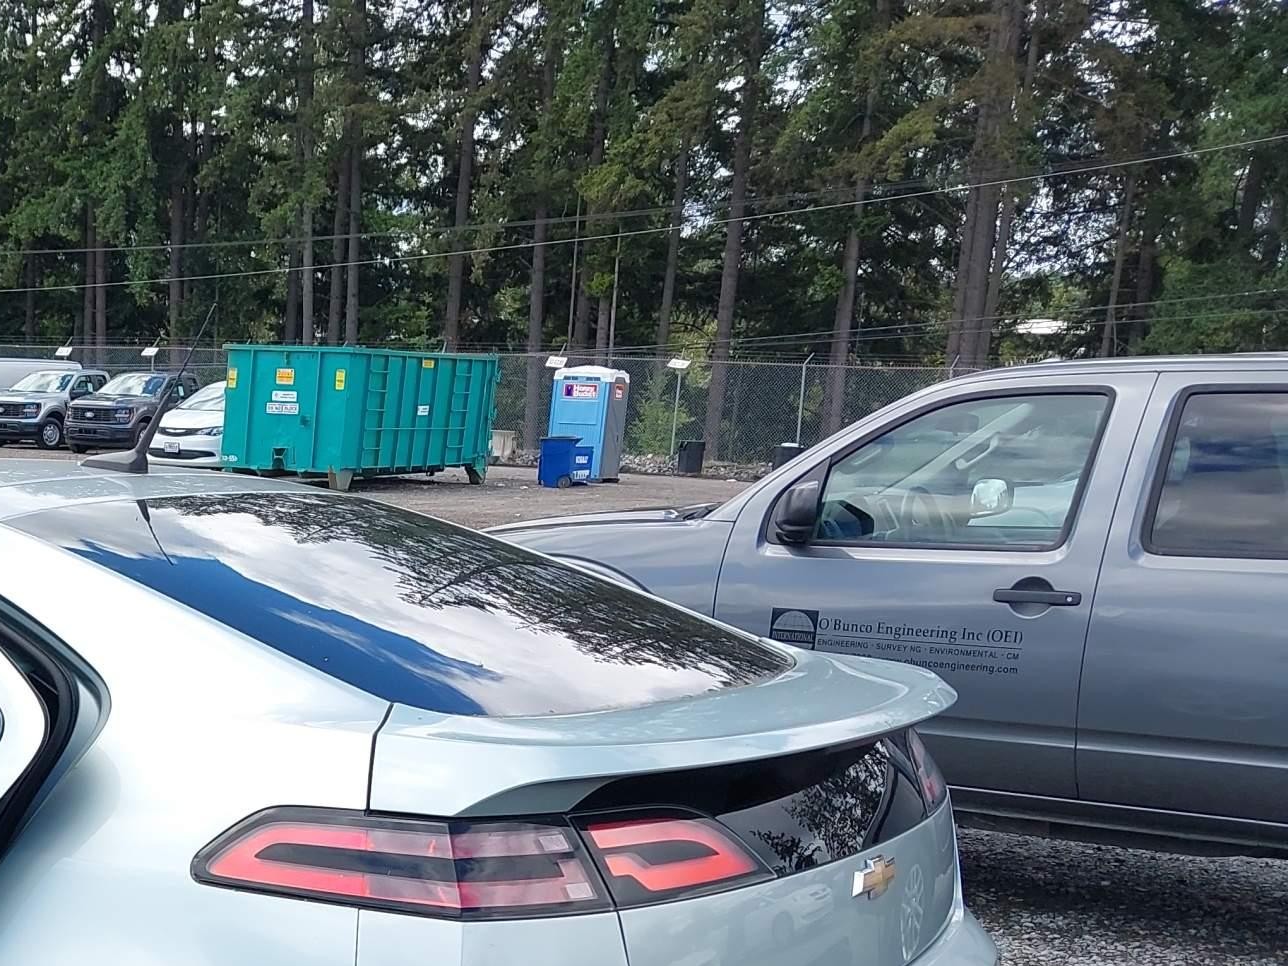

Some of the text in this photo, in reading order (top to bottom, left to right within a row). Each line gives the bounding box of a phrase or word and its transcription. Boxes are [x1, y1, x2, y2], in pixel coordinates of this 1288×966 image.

[819, 618, 1023, 644] O'Bunco Engineering Inc (OEI)
[817, 639, 1019, 660] ENGINEERING SURVEYNG ENVIRONMENTAL CM
